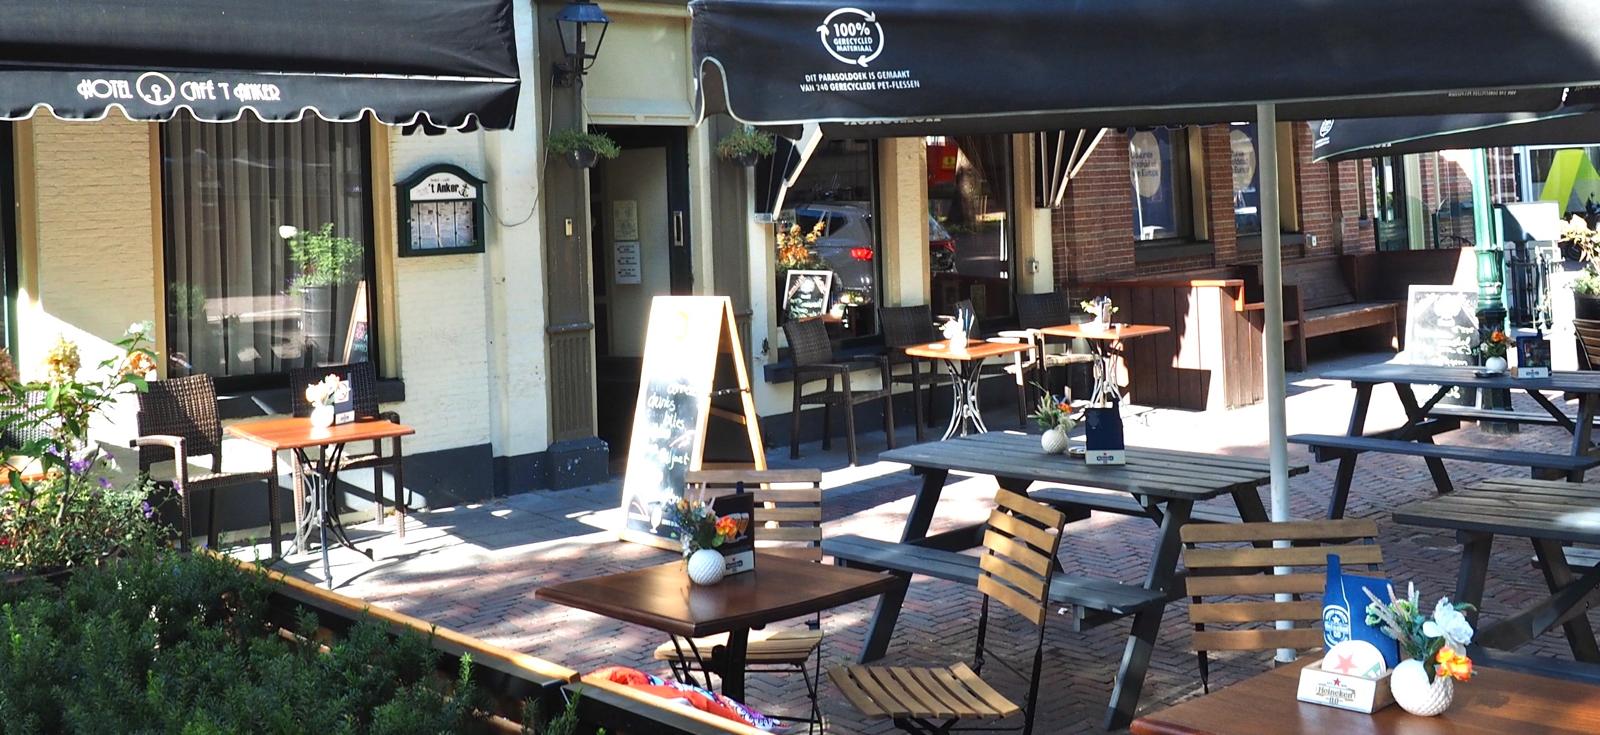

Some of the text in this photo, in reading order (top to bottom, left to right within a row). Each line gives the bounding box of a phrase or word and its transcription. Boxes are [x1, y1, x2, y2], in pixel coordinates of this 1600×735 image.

[833, 22, 870, 37] 100%
[833, 37, 873, 45] GERECYCLED
[804, 70, 910, 83] DIT PARASOLDOEK IS GEMAAKT
[76, 78, 133, 100] HOTEL
[233, 82, 281, 102] ANKER
[800, 79, 920, 92] VAN 240 GERECYCLEDE PET-FLESSEN
[436, 182, 459, 193] Anker
